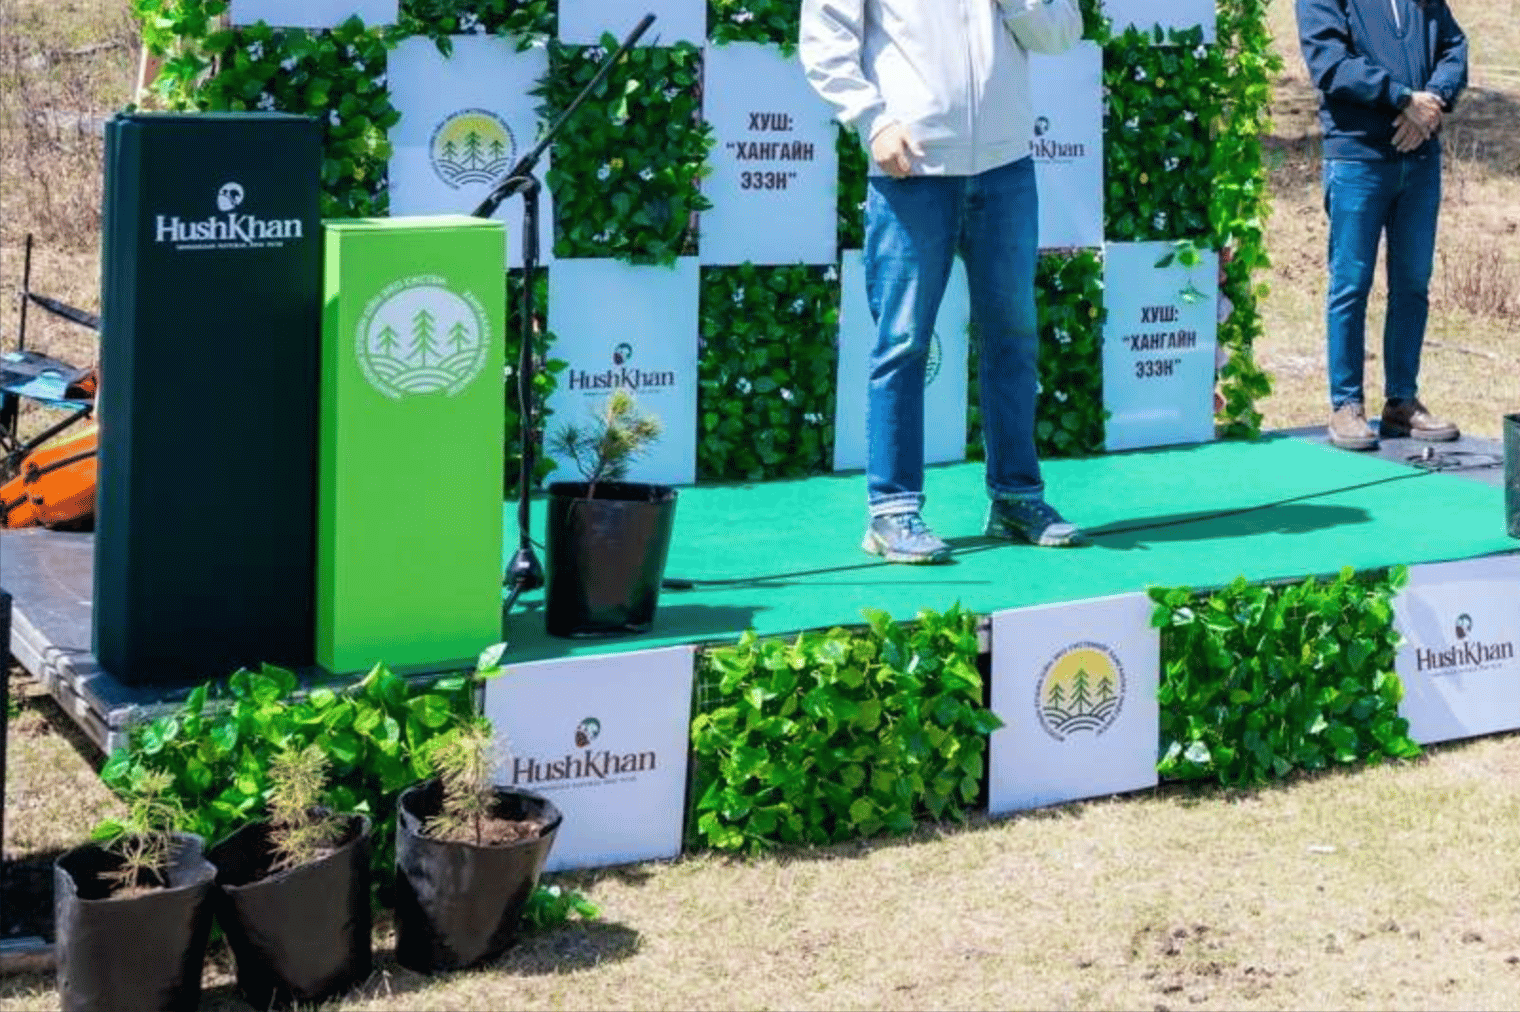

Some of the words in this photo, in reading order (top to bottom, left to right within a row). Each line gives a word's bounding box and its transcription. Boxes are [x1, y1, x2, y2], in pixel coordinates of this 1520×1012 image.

[748, 112, 794, 132] ХУШ:
[726, 140, 814, 161] “ХАНГАЙН
[155, 213, 304, 243] HushKhan
[1141, 305, 1179, 324] ХУШ:
[568, 367, 676, 390] HushKhan
[1416, 641, 1514, 671] HushKhan
[511, 750, 656, 785] HushKhan
